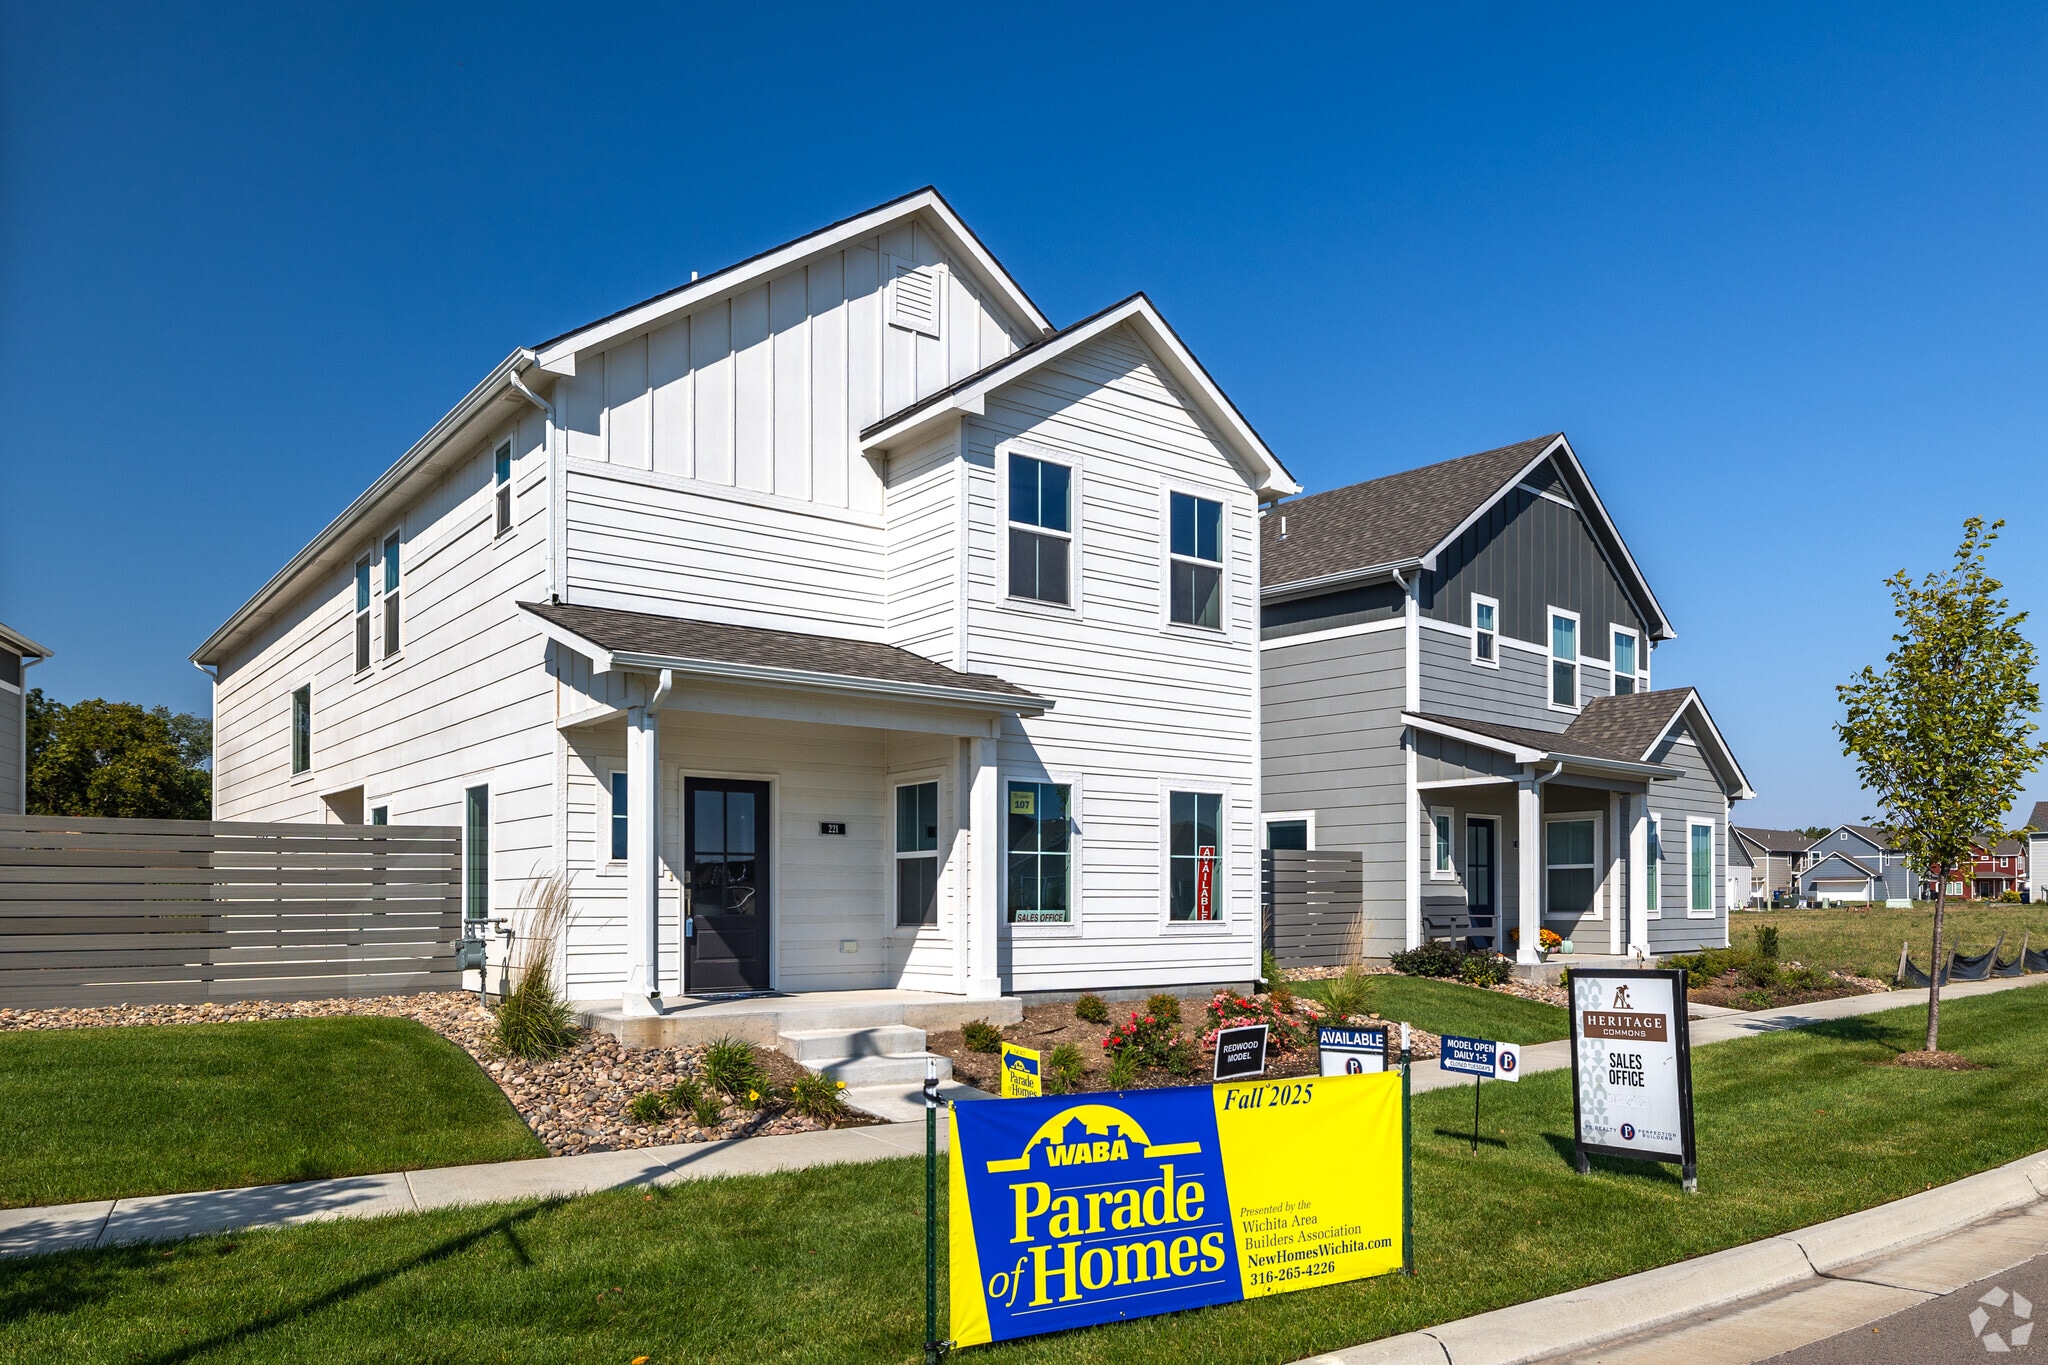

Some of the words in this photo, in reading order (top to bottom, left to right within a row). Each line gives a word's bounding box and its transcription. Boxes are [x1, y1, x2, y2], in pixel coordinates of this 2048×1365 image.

[1014, 800, 1030, 809] 107
[1017, 913, 1038, 922] SALES
[1039, 913, 1063, 922] OFFICE
[1587, 1015, 1662, 1029] HERITAGE
[1320, 1031, 1383, 1047] AVAILABLE
[1603, 1028, 1646, 1037] COMMONS
[1223, 1040, 1259, 1054] REDWOOD
[1447, 1038, 1472, 1051] MODEL
[1474, 1042, 1495, 1053] OPEN
[1227, 1052, 1252, 1063] MODEL
[1454, 1050, 1475, 1060] DAILY
[1475, 1053, 1487, 1062] 1-5
[1609, 1052, 1642, 1070] SALES
[1450, 1060, 1467, 1068] CLOSED
[1468, 1062, 1491, 1072] TUESDAYS
[1010, 1071, 1034, 1088] Parade
[1609, 1069, 1645, 1087] OFFICE
[1223, 1085, 1264, 1111] Fall
[1269, 1083, 1313, 1107] 2025
[1595, 1125, 1617, 1133] REALTY
[1638, 1129, 1677, 1138] PERFECTION
[1046, 1139, 1128, 1167] WABA
[1009, 1163, 1205, 1244] Parade
[1240, 1206, 1283, 1218] Presented
[1285, 1202, 1296, 1214] by
[1298, 1200, 1311, 1210] the
[1243, 1217, 1287, 1234] Wichita
[1292, 1215, 1318, 1227] Area
[1245, 1232, 1294, 1250] Builders
[1298, 1224, 1361, 1242] Association
[1248, 1237, 1392, 1268] NewHomesWichita.com
[988, 1256, 1028, 1307] of
[1027, 1232, 1226, 1307] Homes
[1250, 1261, 1335, 1286] 316-265-4226
